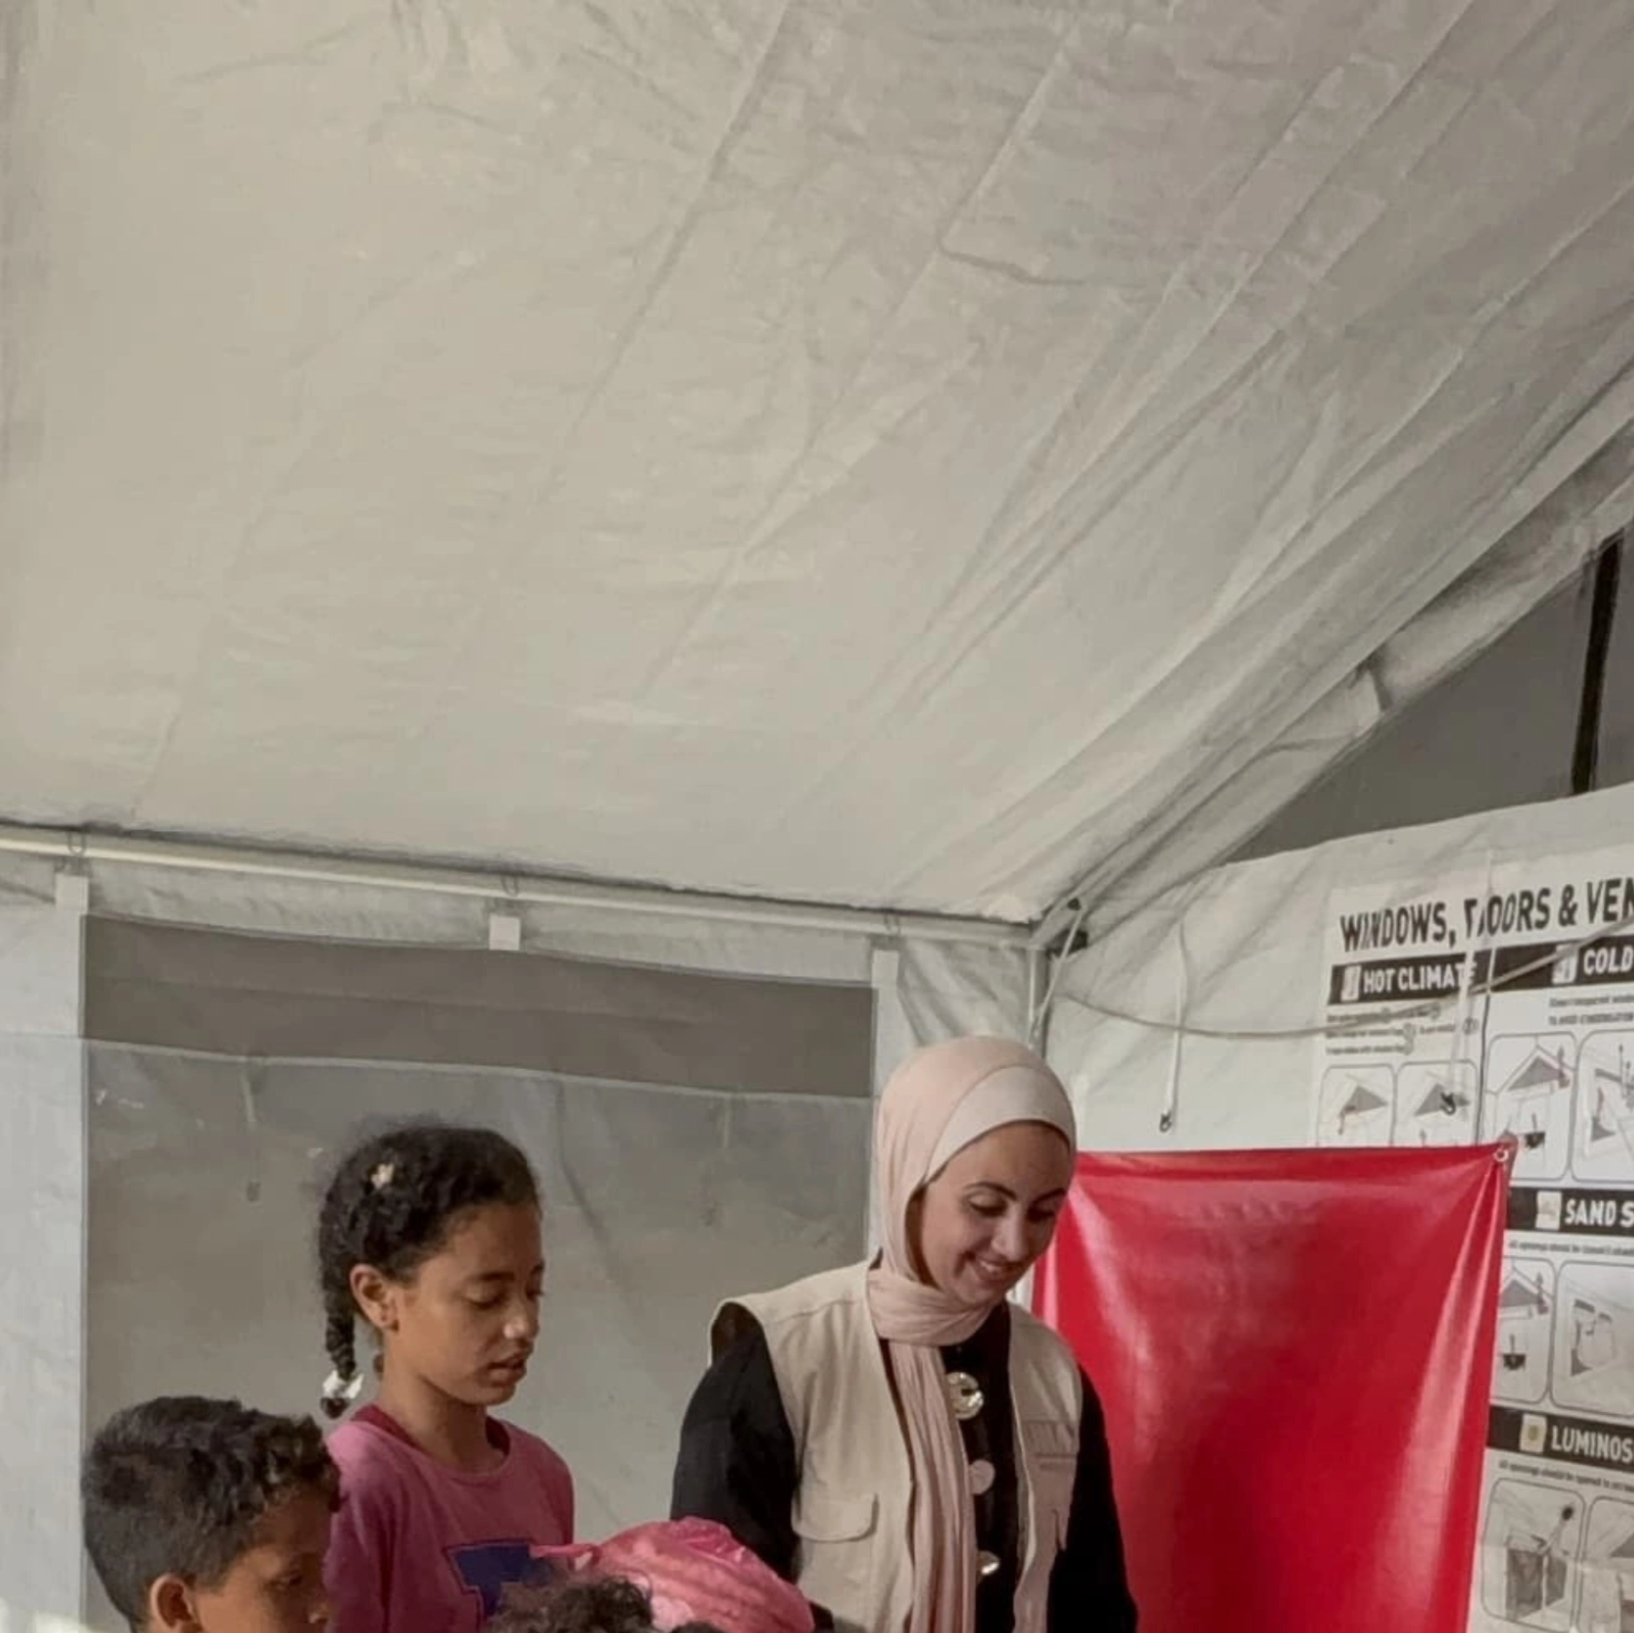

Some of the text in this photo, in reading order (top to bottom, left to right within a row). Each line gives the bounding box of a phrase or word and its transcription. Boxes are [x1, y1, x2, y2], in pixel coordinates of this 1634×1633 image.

[1340, 902, 1456, 951] WINDOWS,
[1558, 884, 1577, 926] &
[1583, 946, 1633, 976] COLD
[1363, 968, 1394, 994] HOT
[1564, 1198, 1615, 1227] SAND
